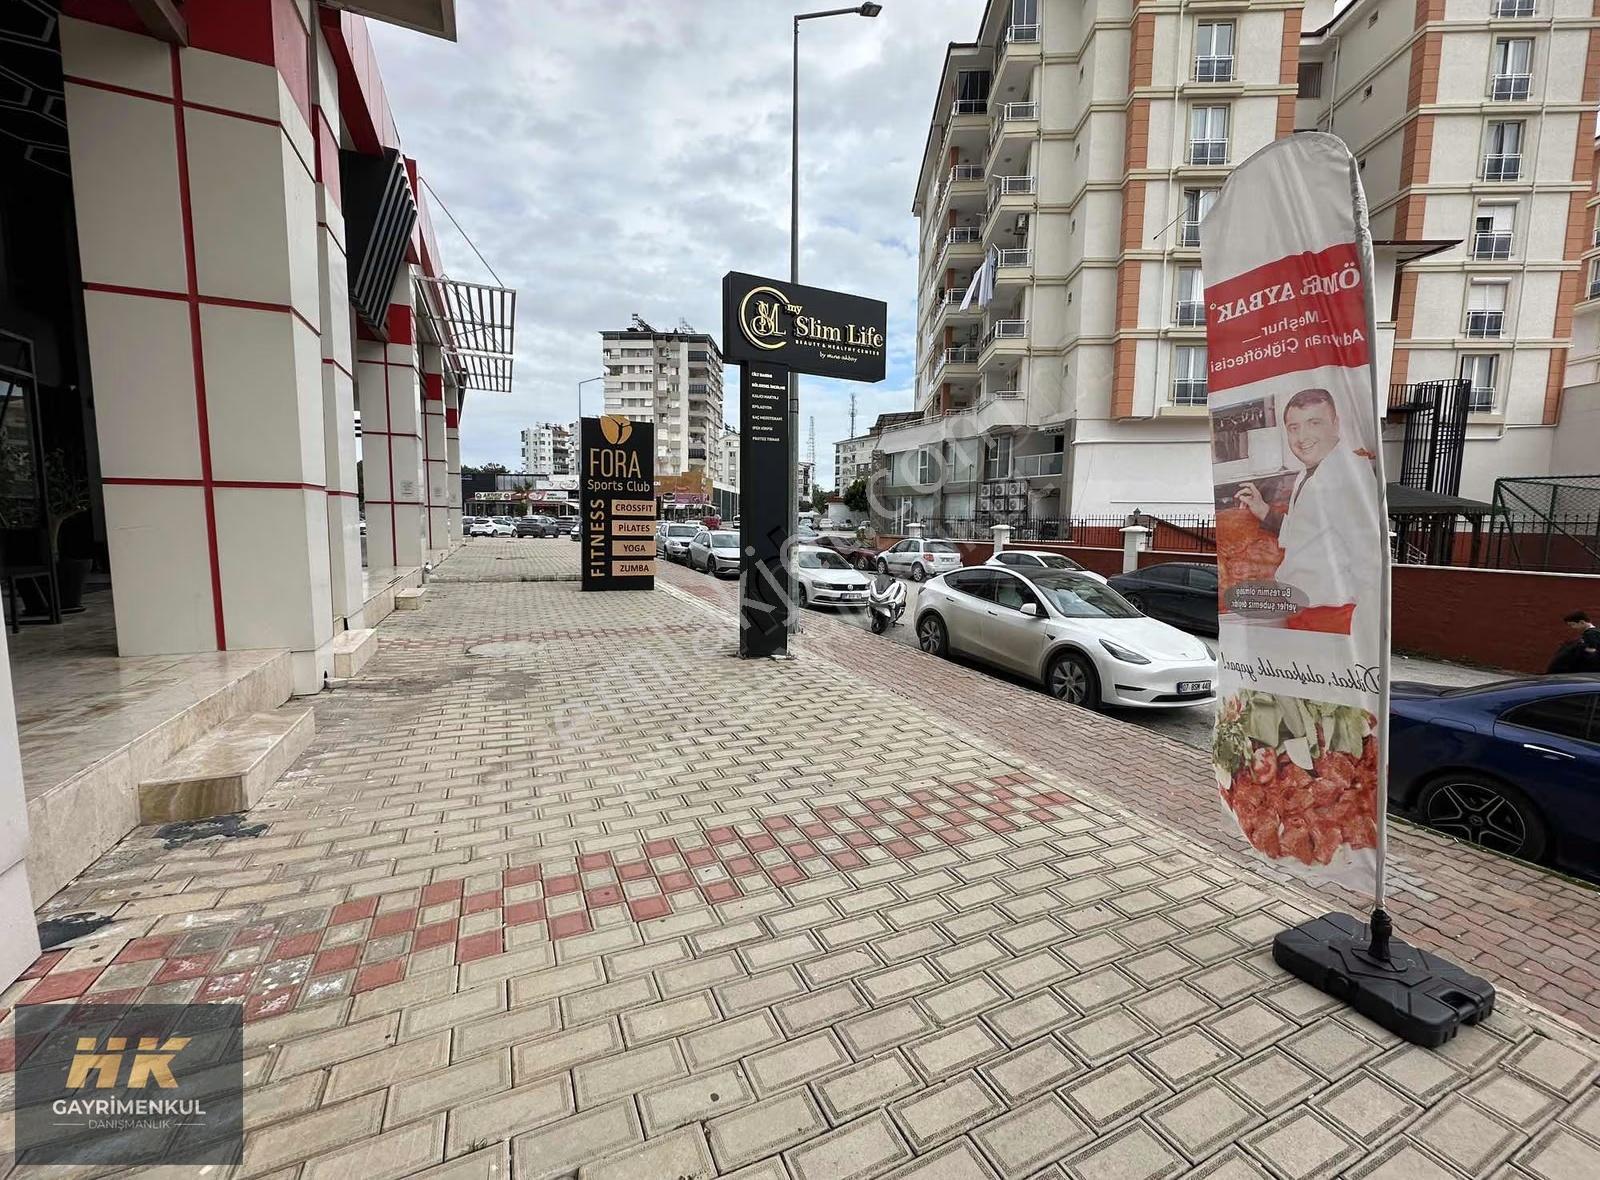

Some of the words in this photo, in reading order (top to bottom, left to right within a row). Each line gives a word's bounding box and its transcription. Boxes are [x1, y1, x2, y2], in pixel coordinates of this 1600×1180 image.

[786, 303, 802, 315] my
[796, 315, 841, 341] Slim
[847, 324, 883, 347] Life
[590, 447, 641, 479] FORA
[587, 479, 623, 492] Sports
[627, 480, 651, 492] Club
[615, 503, 653, 512] CROSSFIT
[618, 523, 650, 532] PİLATES
[590, 499, 605, 577] FITNESS
[624, 544, 646, 553] YOGA
[620, 564, 649, 573] ZUMBA
